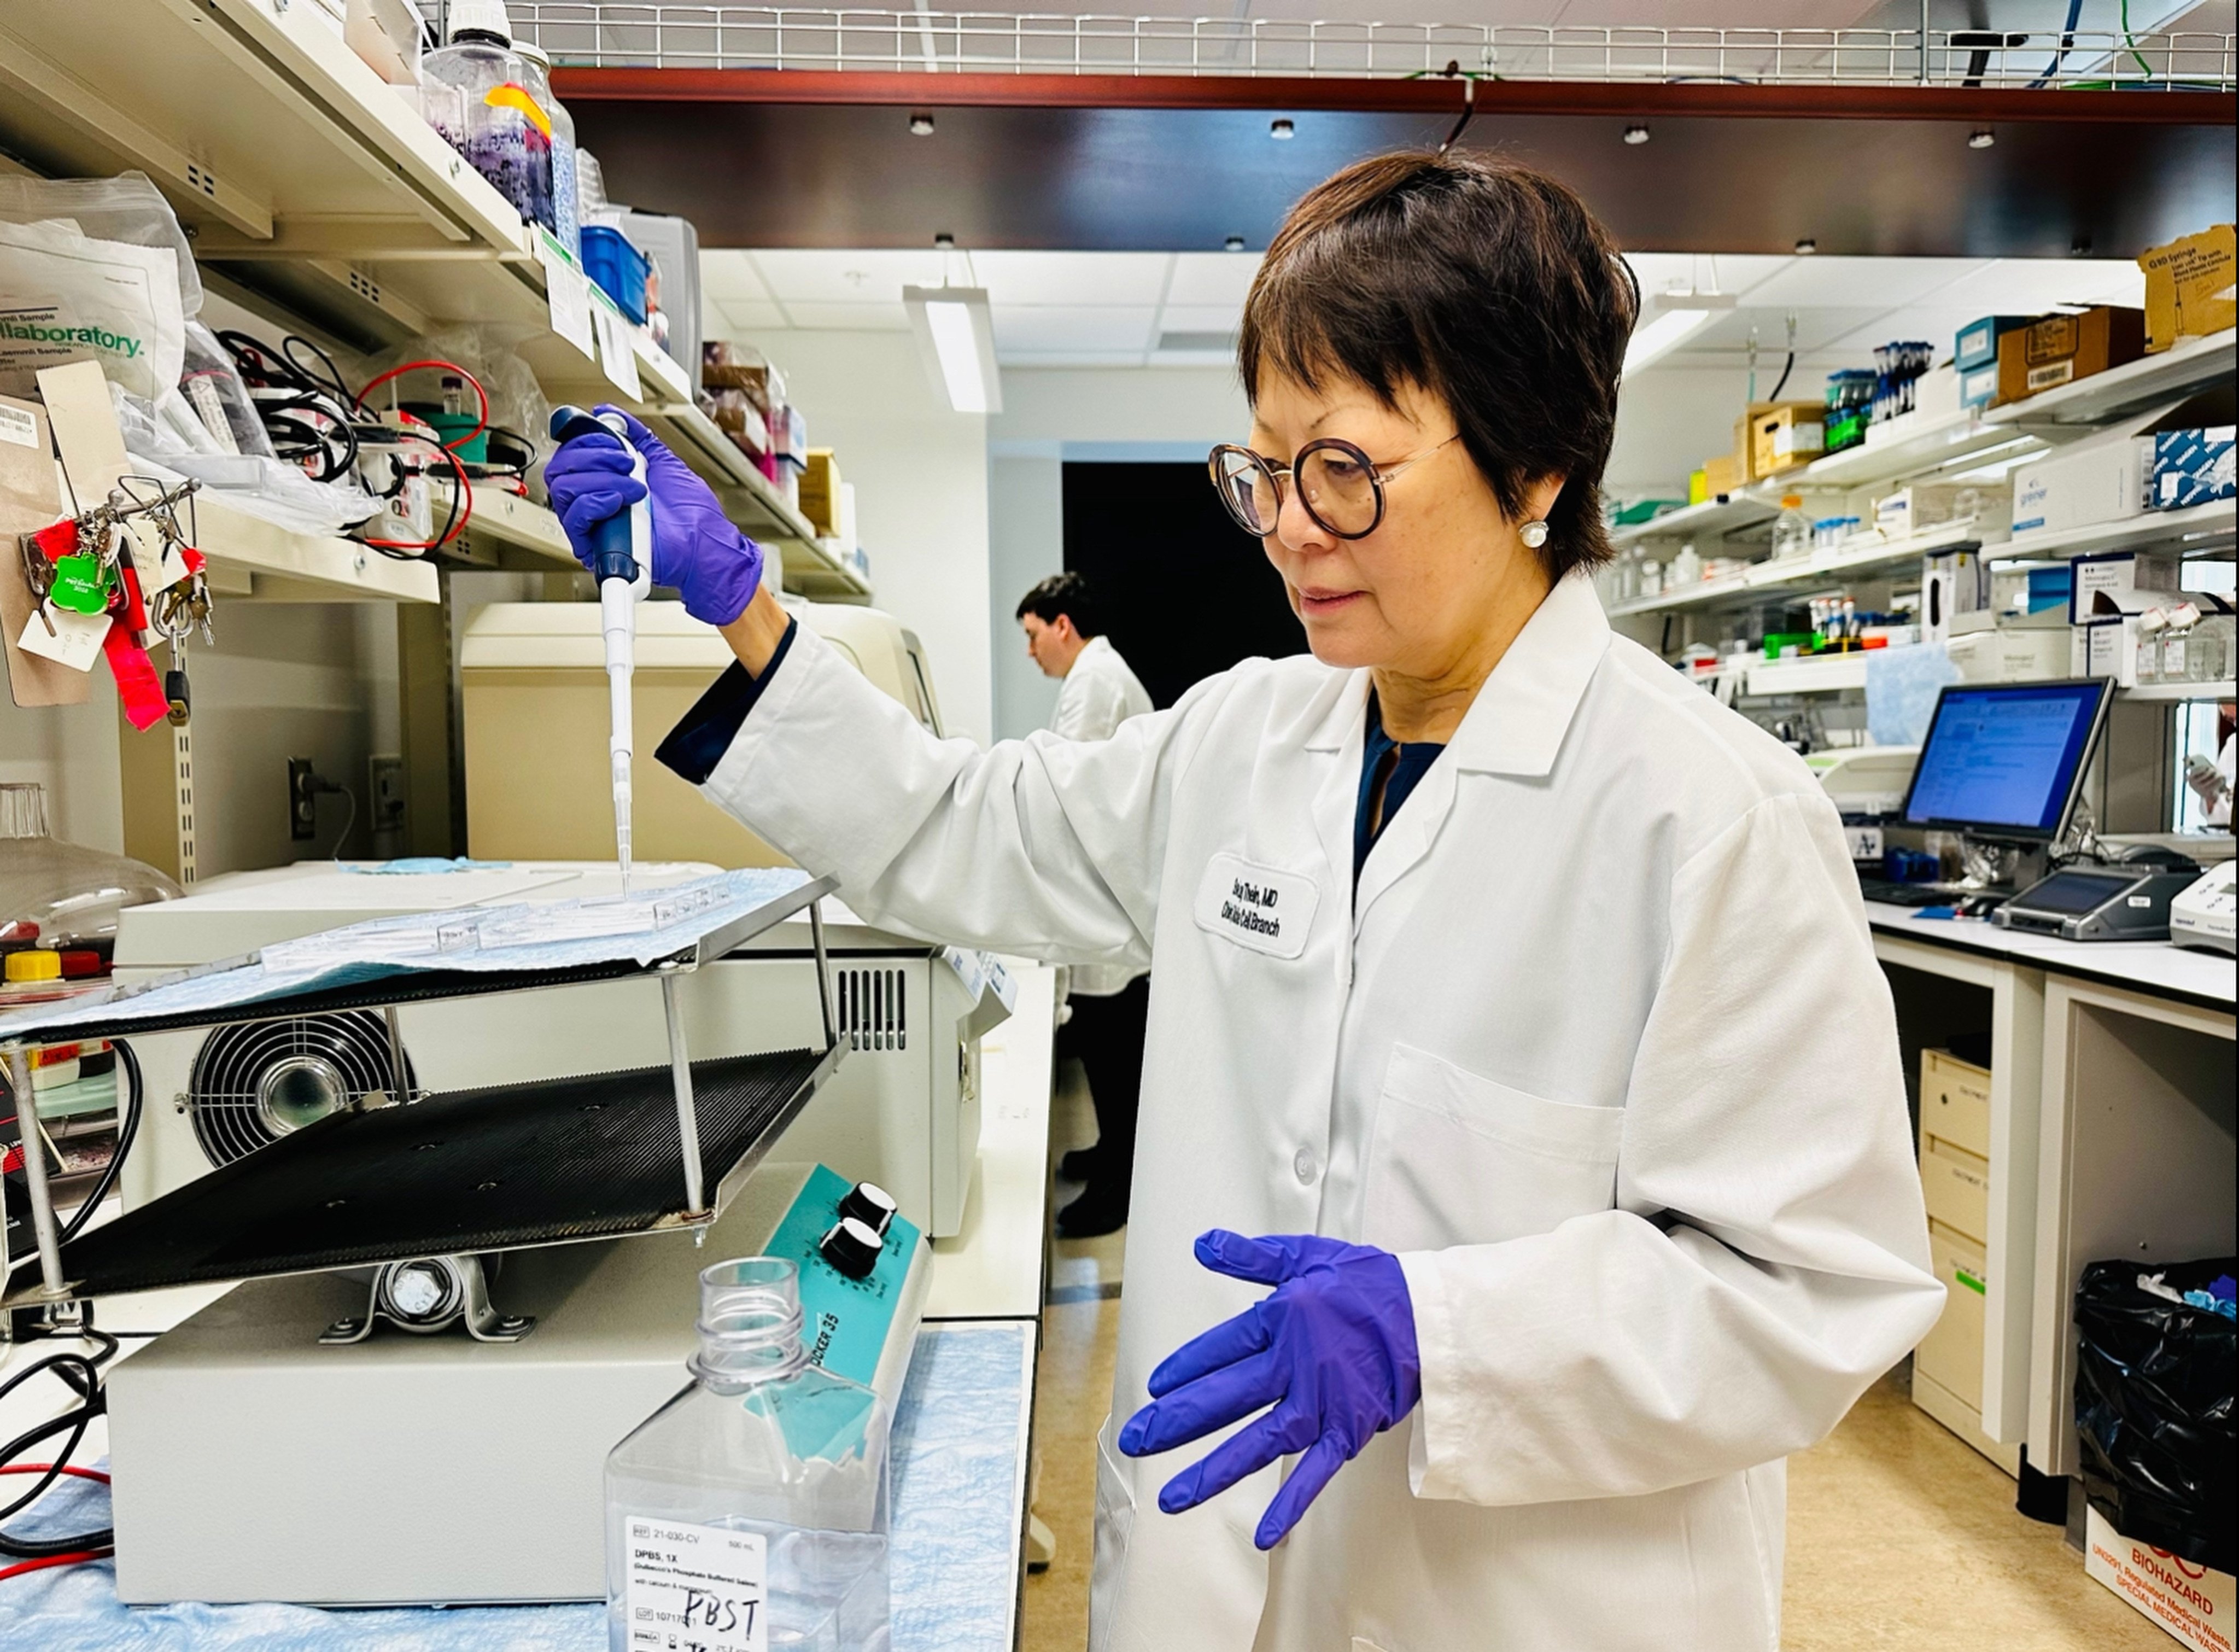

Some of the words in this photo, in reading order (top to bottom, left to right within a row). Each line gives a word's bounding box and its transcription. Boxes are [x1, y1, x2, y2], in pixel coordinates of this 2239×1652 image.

[2168, 248, 2196, 262] Syringe
[20, 313, 55, 321] Sample
[37, 347, 72, 357] Sample
[2159, 430, 2181, 453] QIAGEN
[2175, 444, 2198, 466] QIAGEN
[1261, 887, 1278, 908] MD
[1250, 912, 1279, 938] Branch
[822, 1312, 839, 1332] 35
[653, 1529, 700, 1544] 21-030-CV
[665, 1553, 678, 1563] 1X
[673, 1568, 706, 1579] Phosphate
[708, 1573, 735, 1584] Buffered
[2132, 1548, 2213, 1615] BIOHAZARD
[2116, 1574, 2152, 1608] SPECIAL
[2153, 1602, 2194, 1639] MEDICAL
[2124, 1566, 2166, 1603] Regulated
[2167, 1596, 2201, 1629] Medical
[685, 1590, 760, 1641] PBST
